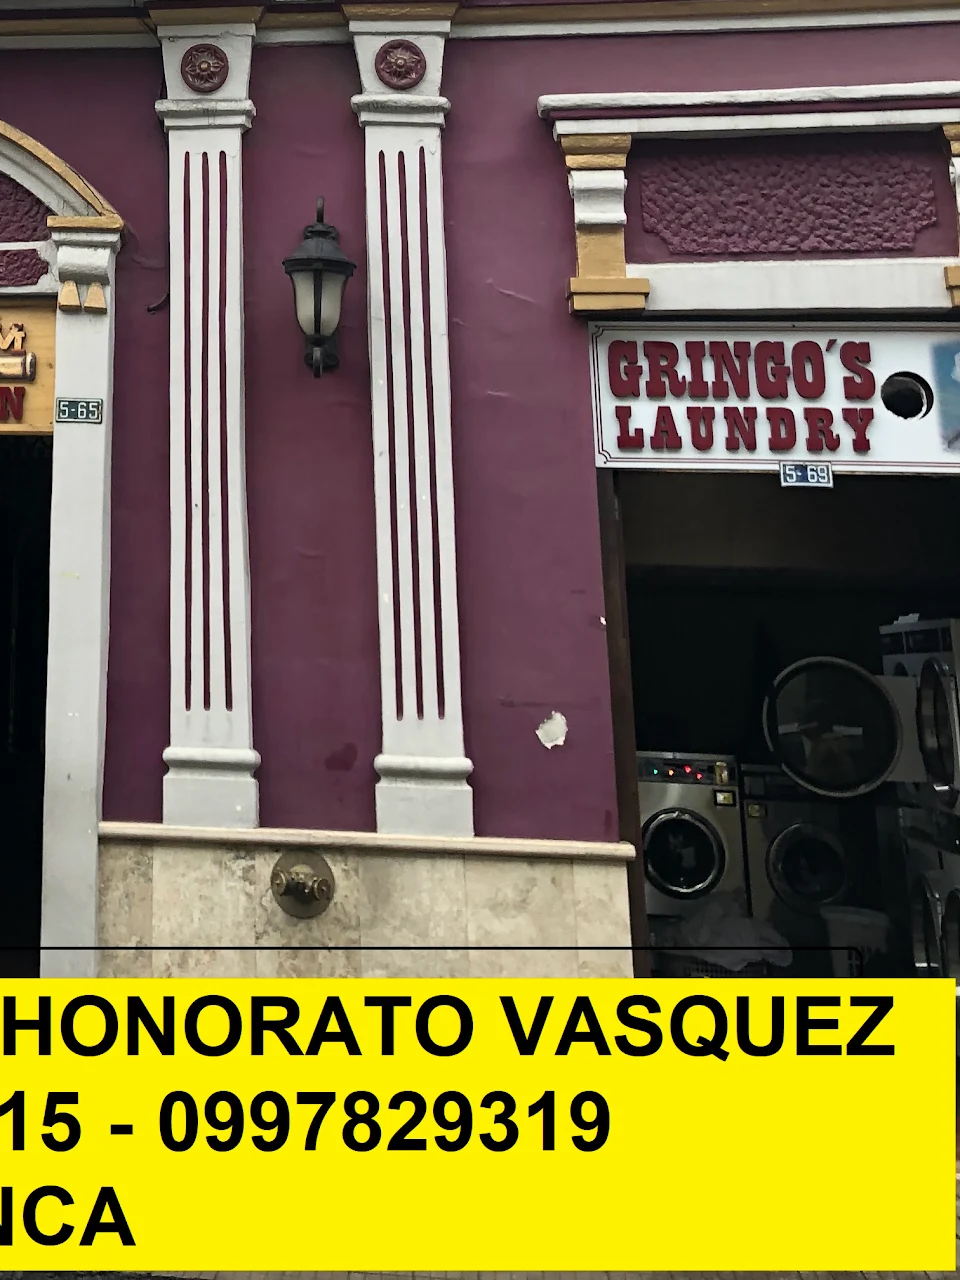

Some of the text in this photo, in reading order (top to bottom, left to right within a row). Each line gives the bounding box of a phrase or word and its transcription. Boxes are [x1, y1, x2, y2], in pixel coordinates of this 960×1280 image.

[607, 339, 876, 401] GRINGO'S
[59, 401, 98, 419] 5-65
[615, 405, 875, 453] LAUNDRY
[785, 465, 828, 483] 5-69
